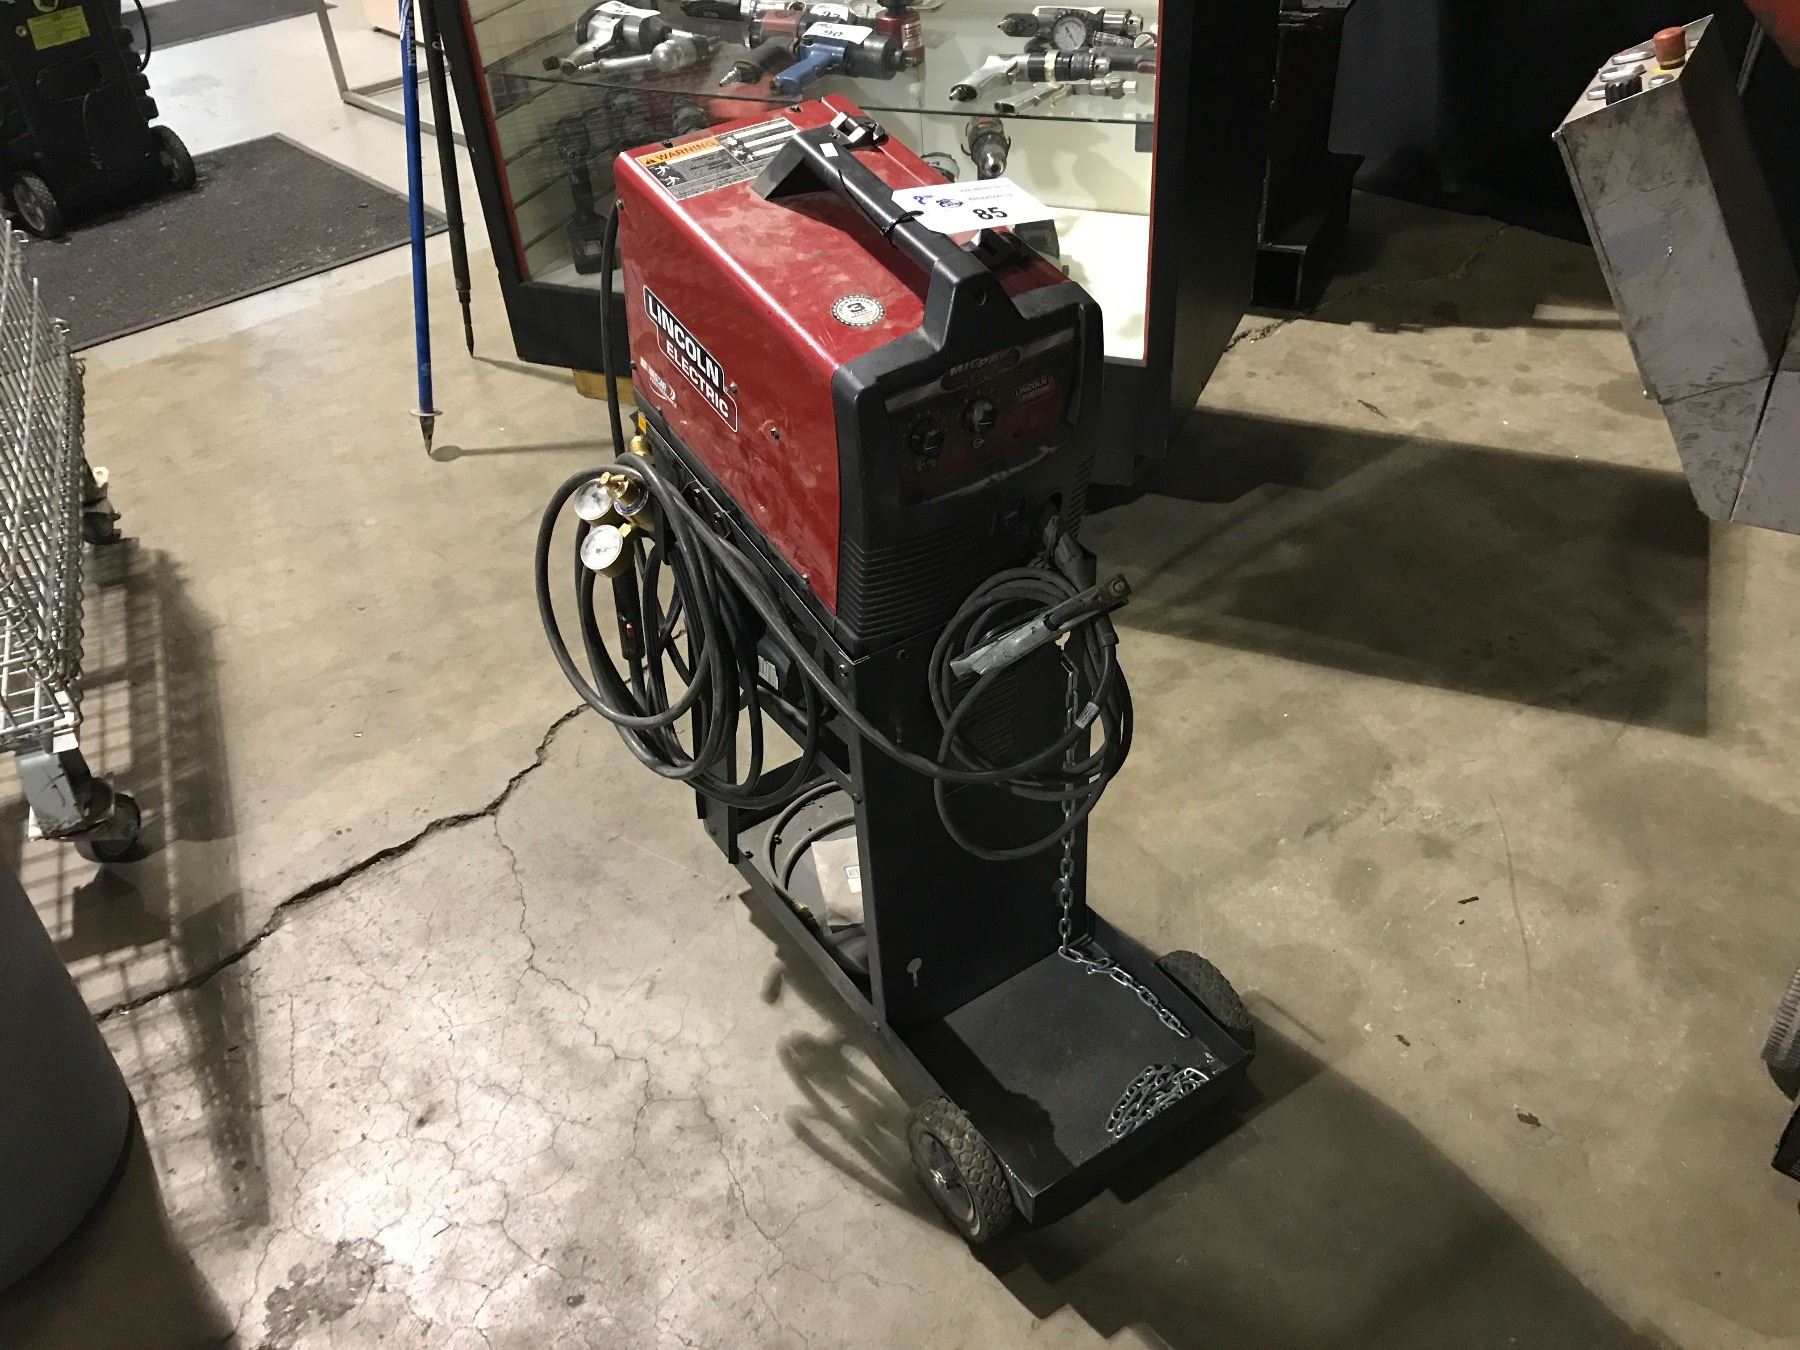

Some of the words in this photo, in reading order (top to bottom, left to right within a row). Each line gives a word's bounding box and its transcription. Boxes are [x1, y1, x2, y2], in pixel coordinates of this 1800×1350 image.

[658, 140, 716, 162] WARNING
[973, 206, 1008, 220] 85
[847, 302, 866, 313] 3
[648, 295, 720, 388] LINCOLN
[666, 339, 729, 418] ELECTRIC
[1015, 377, 1047, 396] LINCOLN
